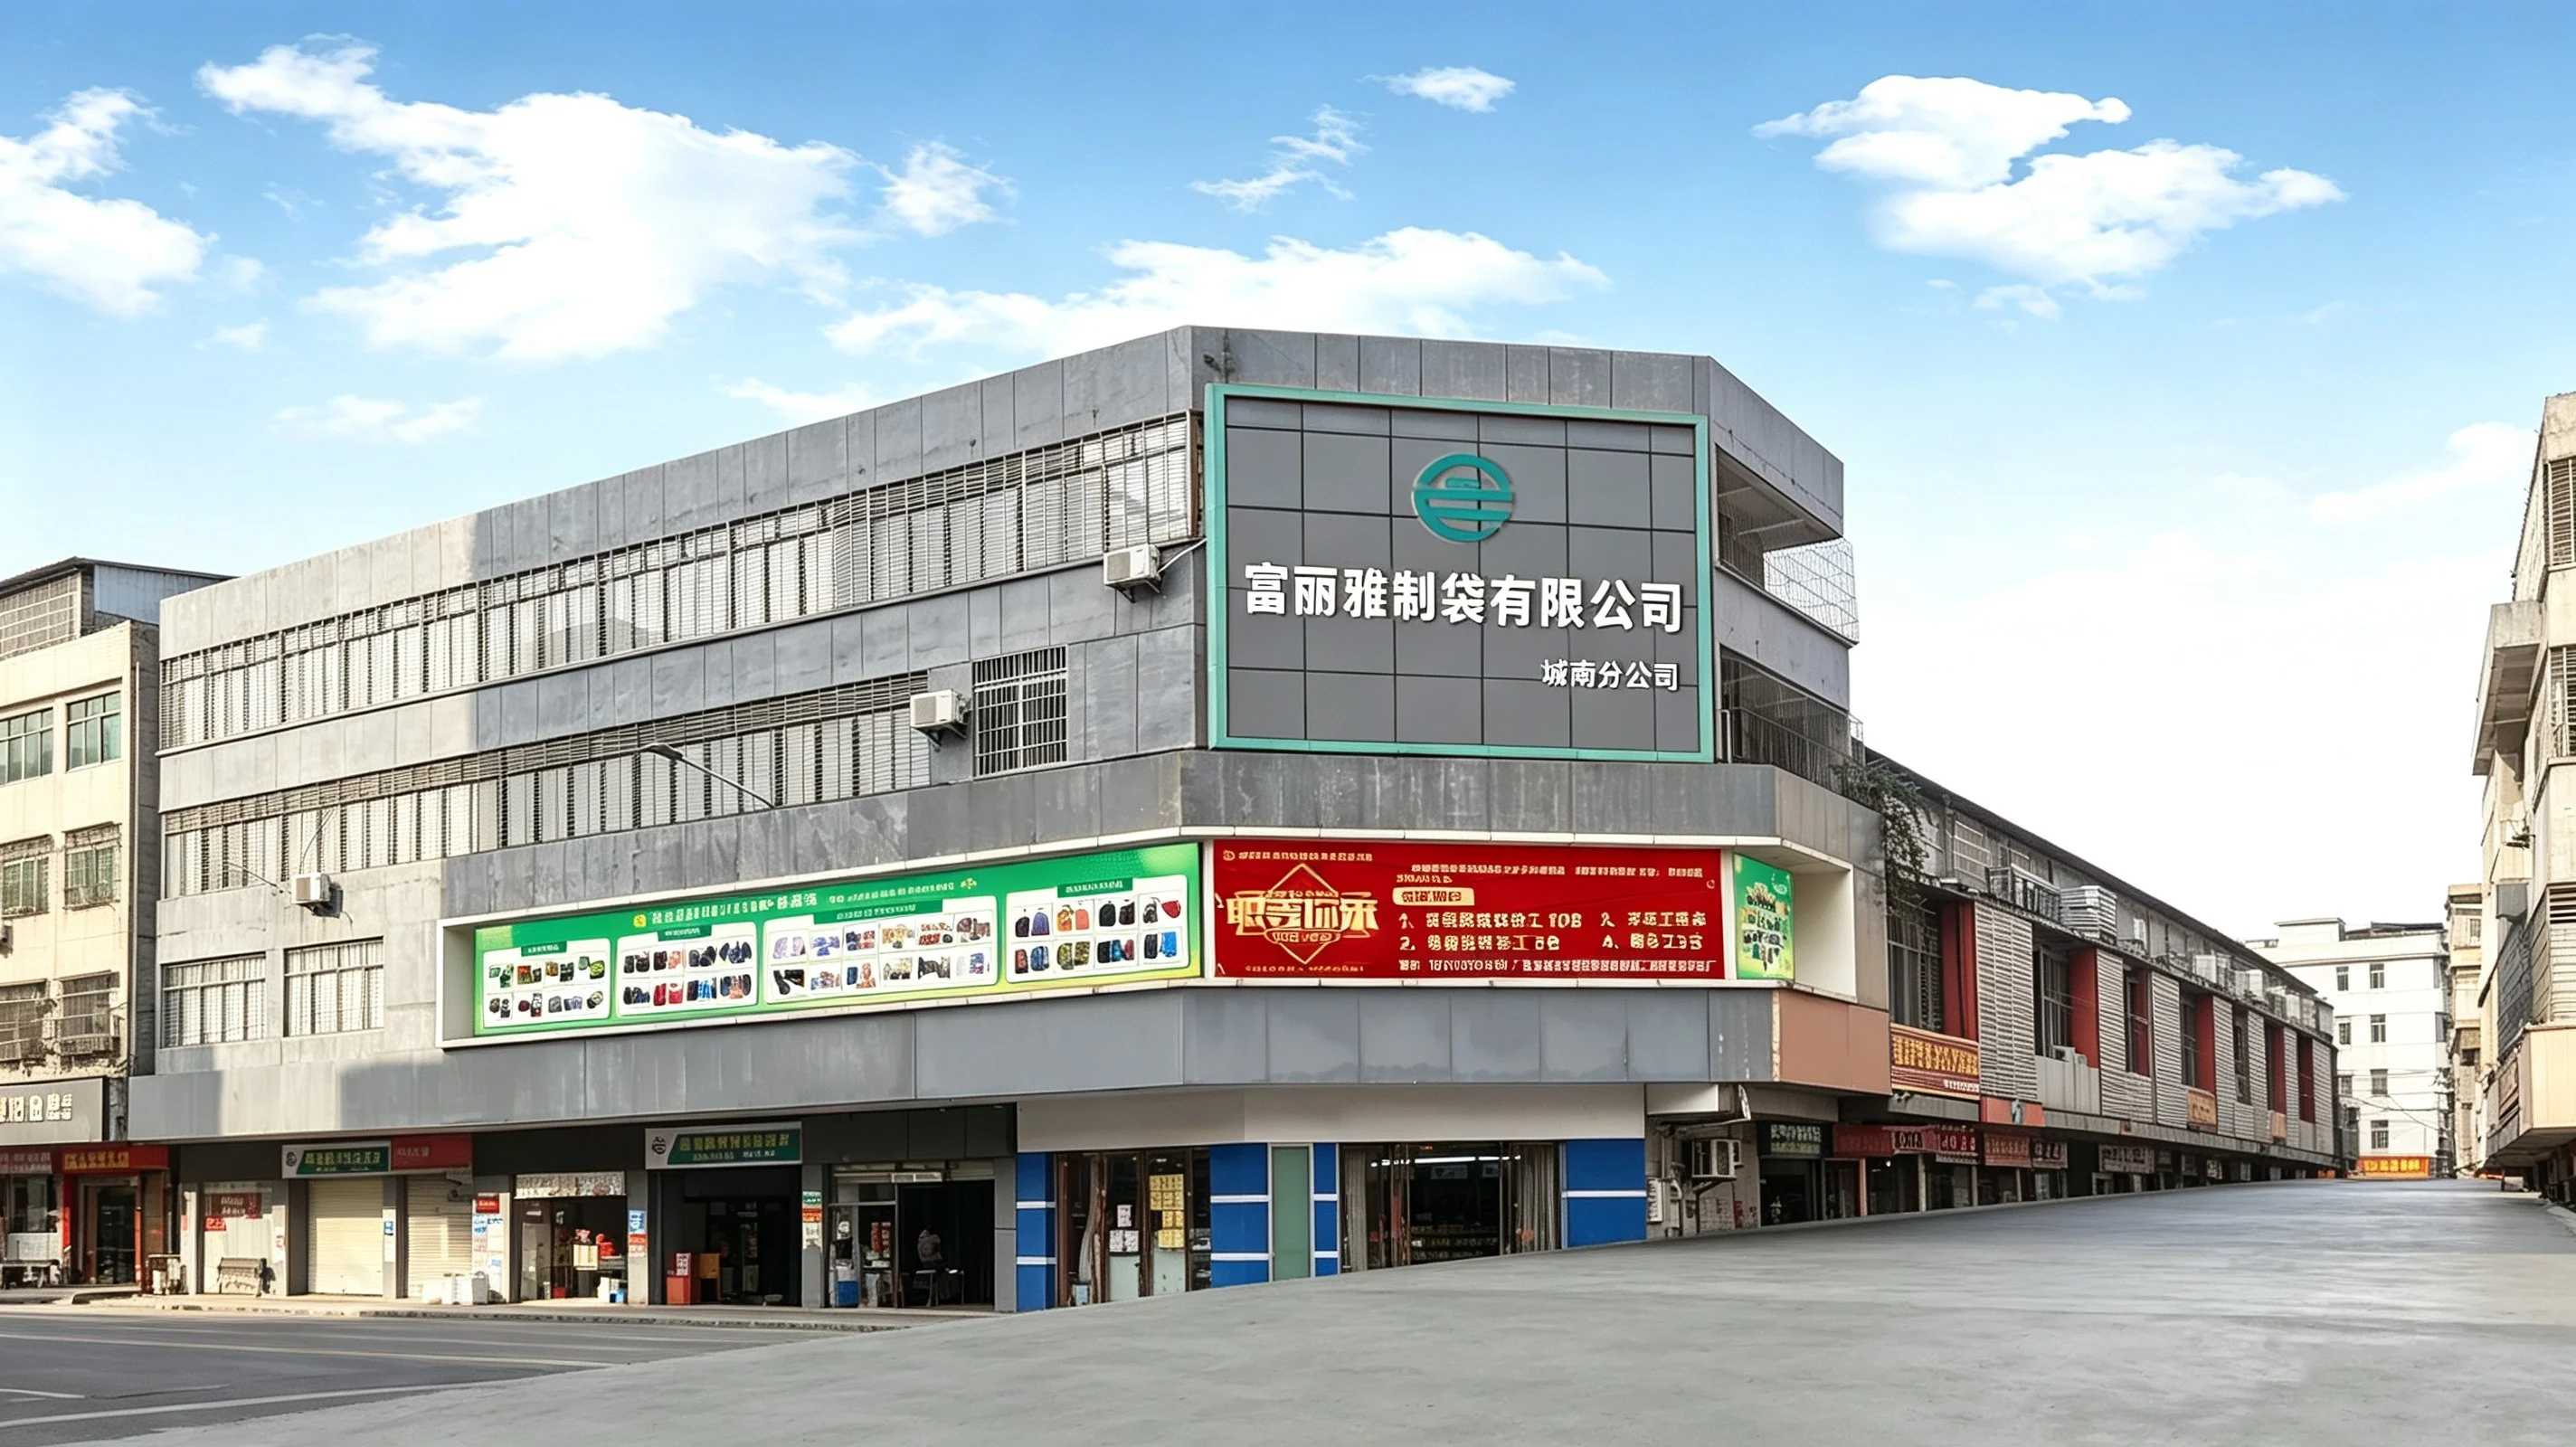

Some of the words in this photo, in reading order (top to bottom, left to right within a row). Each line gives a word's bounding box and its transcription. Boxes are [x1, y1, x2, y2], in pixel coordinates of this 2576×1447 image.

[1245, 562, 1683, 633] 富丽雅制袋有限公司
[1540, 658, 1679, 691] 城南分公司
